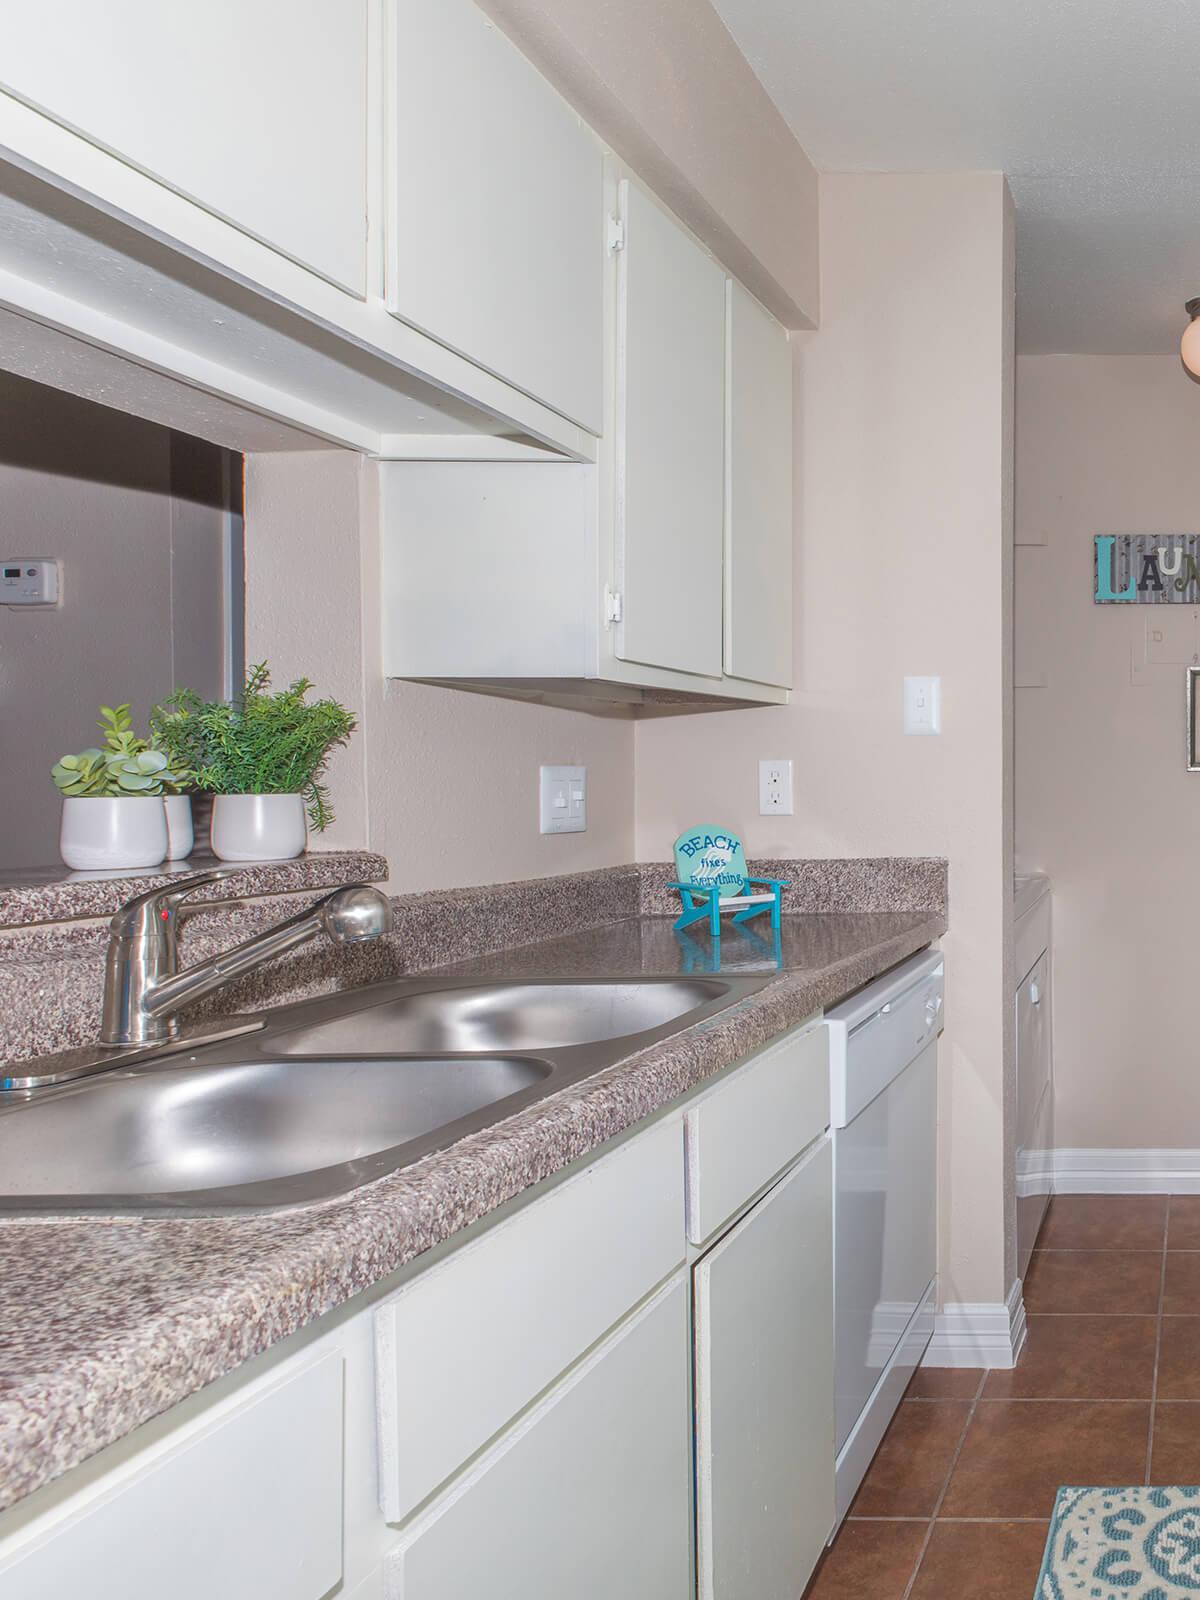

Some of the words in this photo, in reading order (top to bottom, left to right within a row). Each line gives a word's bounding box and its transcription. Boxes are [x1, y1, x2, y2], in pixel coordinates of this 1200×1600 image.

[679, 835, 740, 858] BEACH
[700, 857, 727, 868] fixes
[690, 872, 744, 887] Everything
